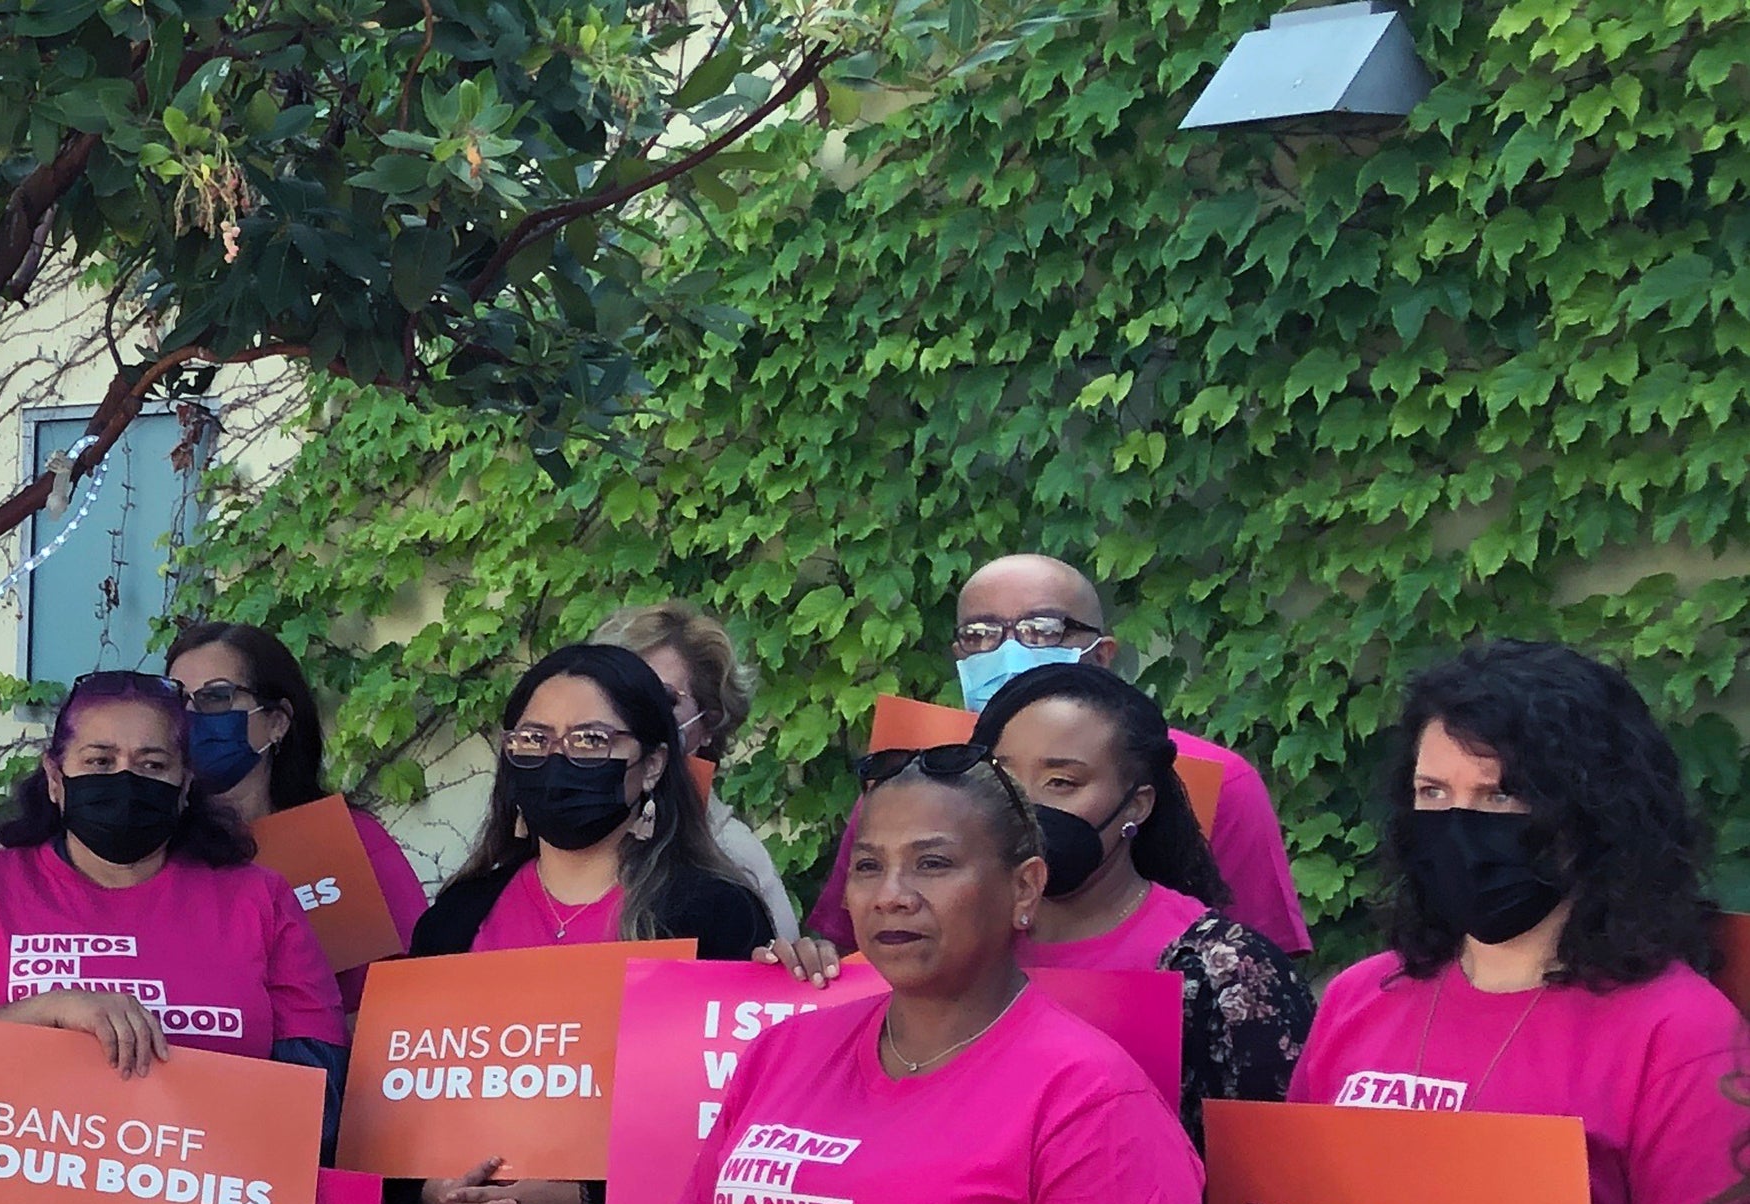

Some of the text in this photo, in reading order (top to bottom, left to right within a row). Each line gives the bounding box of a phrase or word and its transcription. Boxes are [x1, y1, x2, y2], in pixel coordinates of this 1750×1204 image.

[14, 937, 131, 954] JUNTOS
[12, 958, 75, 977] CON
[704, 1001, 720, 1038] I
[388, 1023, 581, 1061] BANS OFF
[382, 1064, 602, 1100] OUR BODI
[1350, 1076, 1459, 1112] STAND
[117, 1120, 205, 1161] OFF
[748, 1129, 849, 1157] STAND
[723, 1158, 792, 1185] WITH
